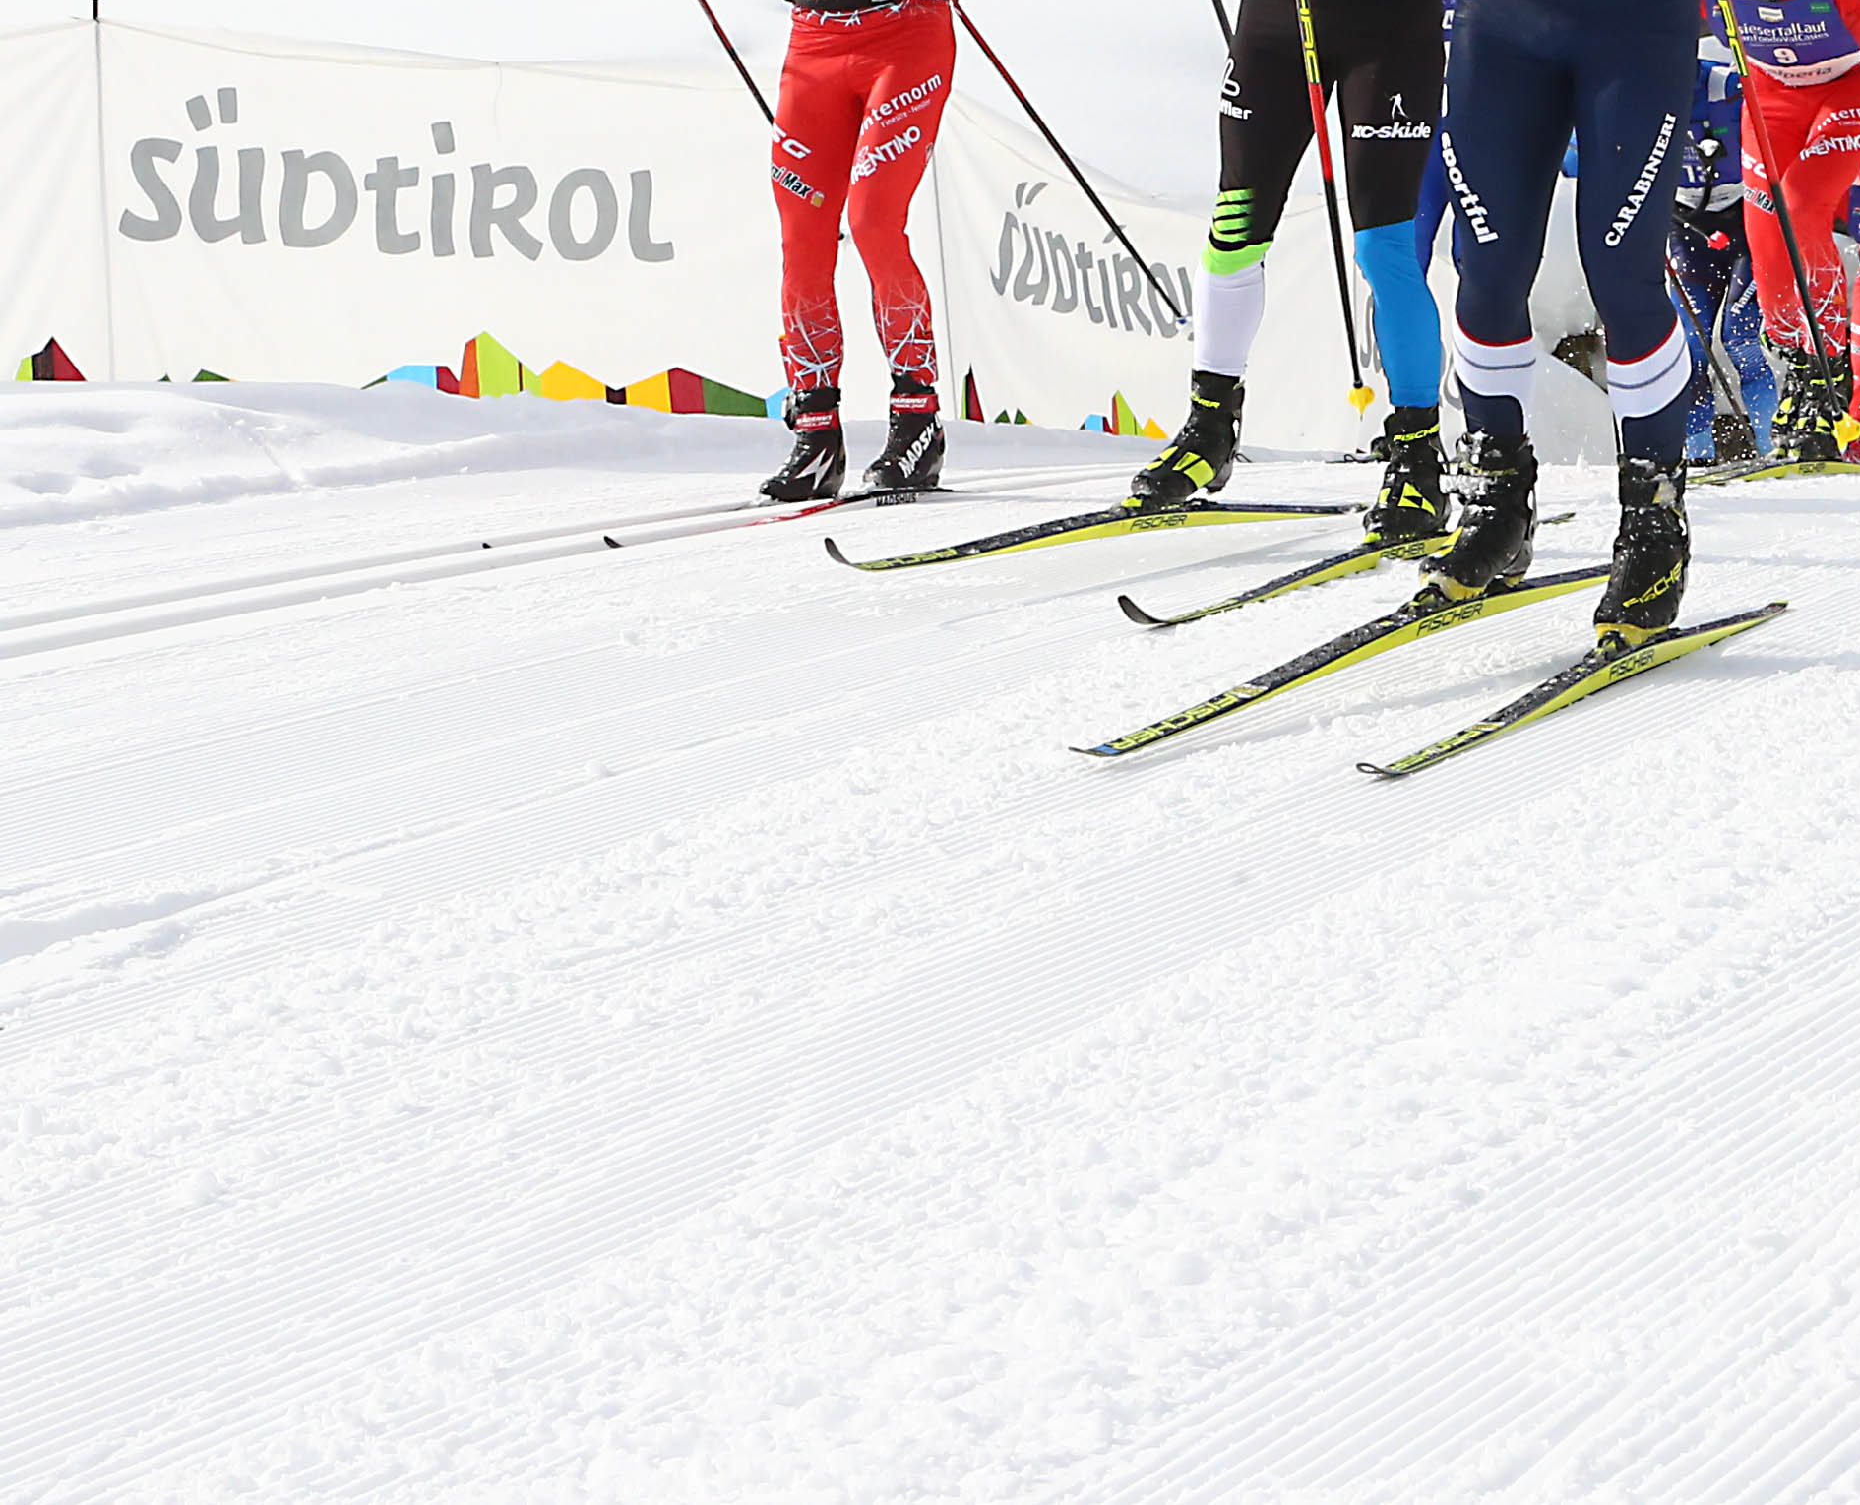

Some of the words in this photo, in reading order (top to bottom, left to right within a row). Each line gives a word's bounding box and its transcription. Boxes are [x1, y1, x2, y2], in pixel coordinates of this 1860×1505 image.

[1738, 20, 1828, 41] sieserTalLauf
[1773, 46, 1798, 65] 9
[1440, 131, 1500, 245] sportful
[1604, 111, 1678, 248] CARABINIERI
[1129, 513, 1188, 531] FISCHER
[1416, 601, 1484, 638] FISCHER
[1608, 648, 1656, 682] FISCHER
